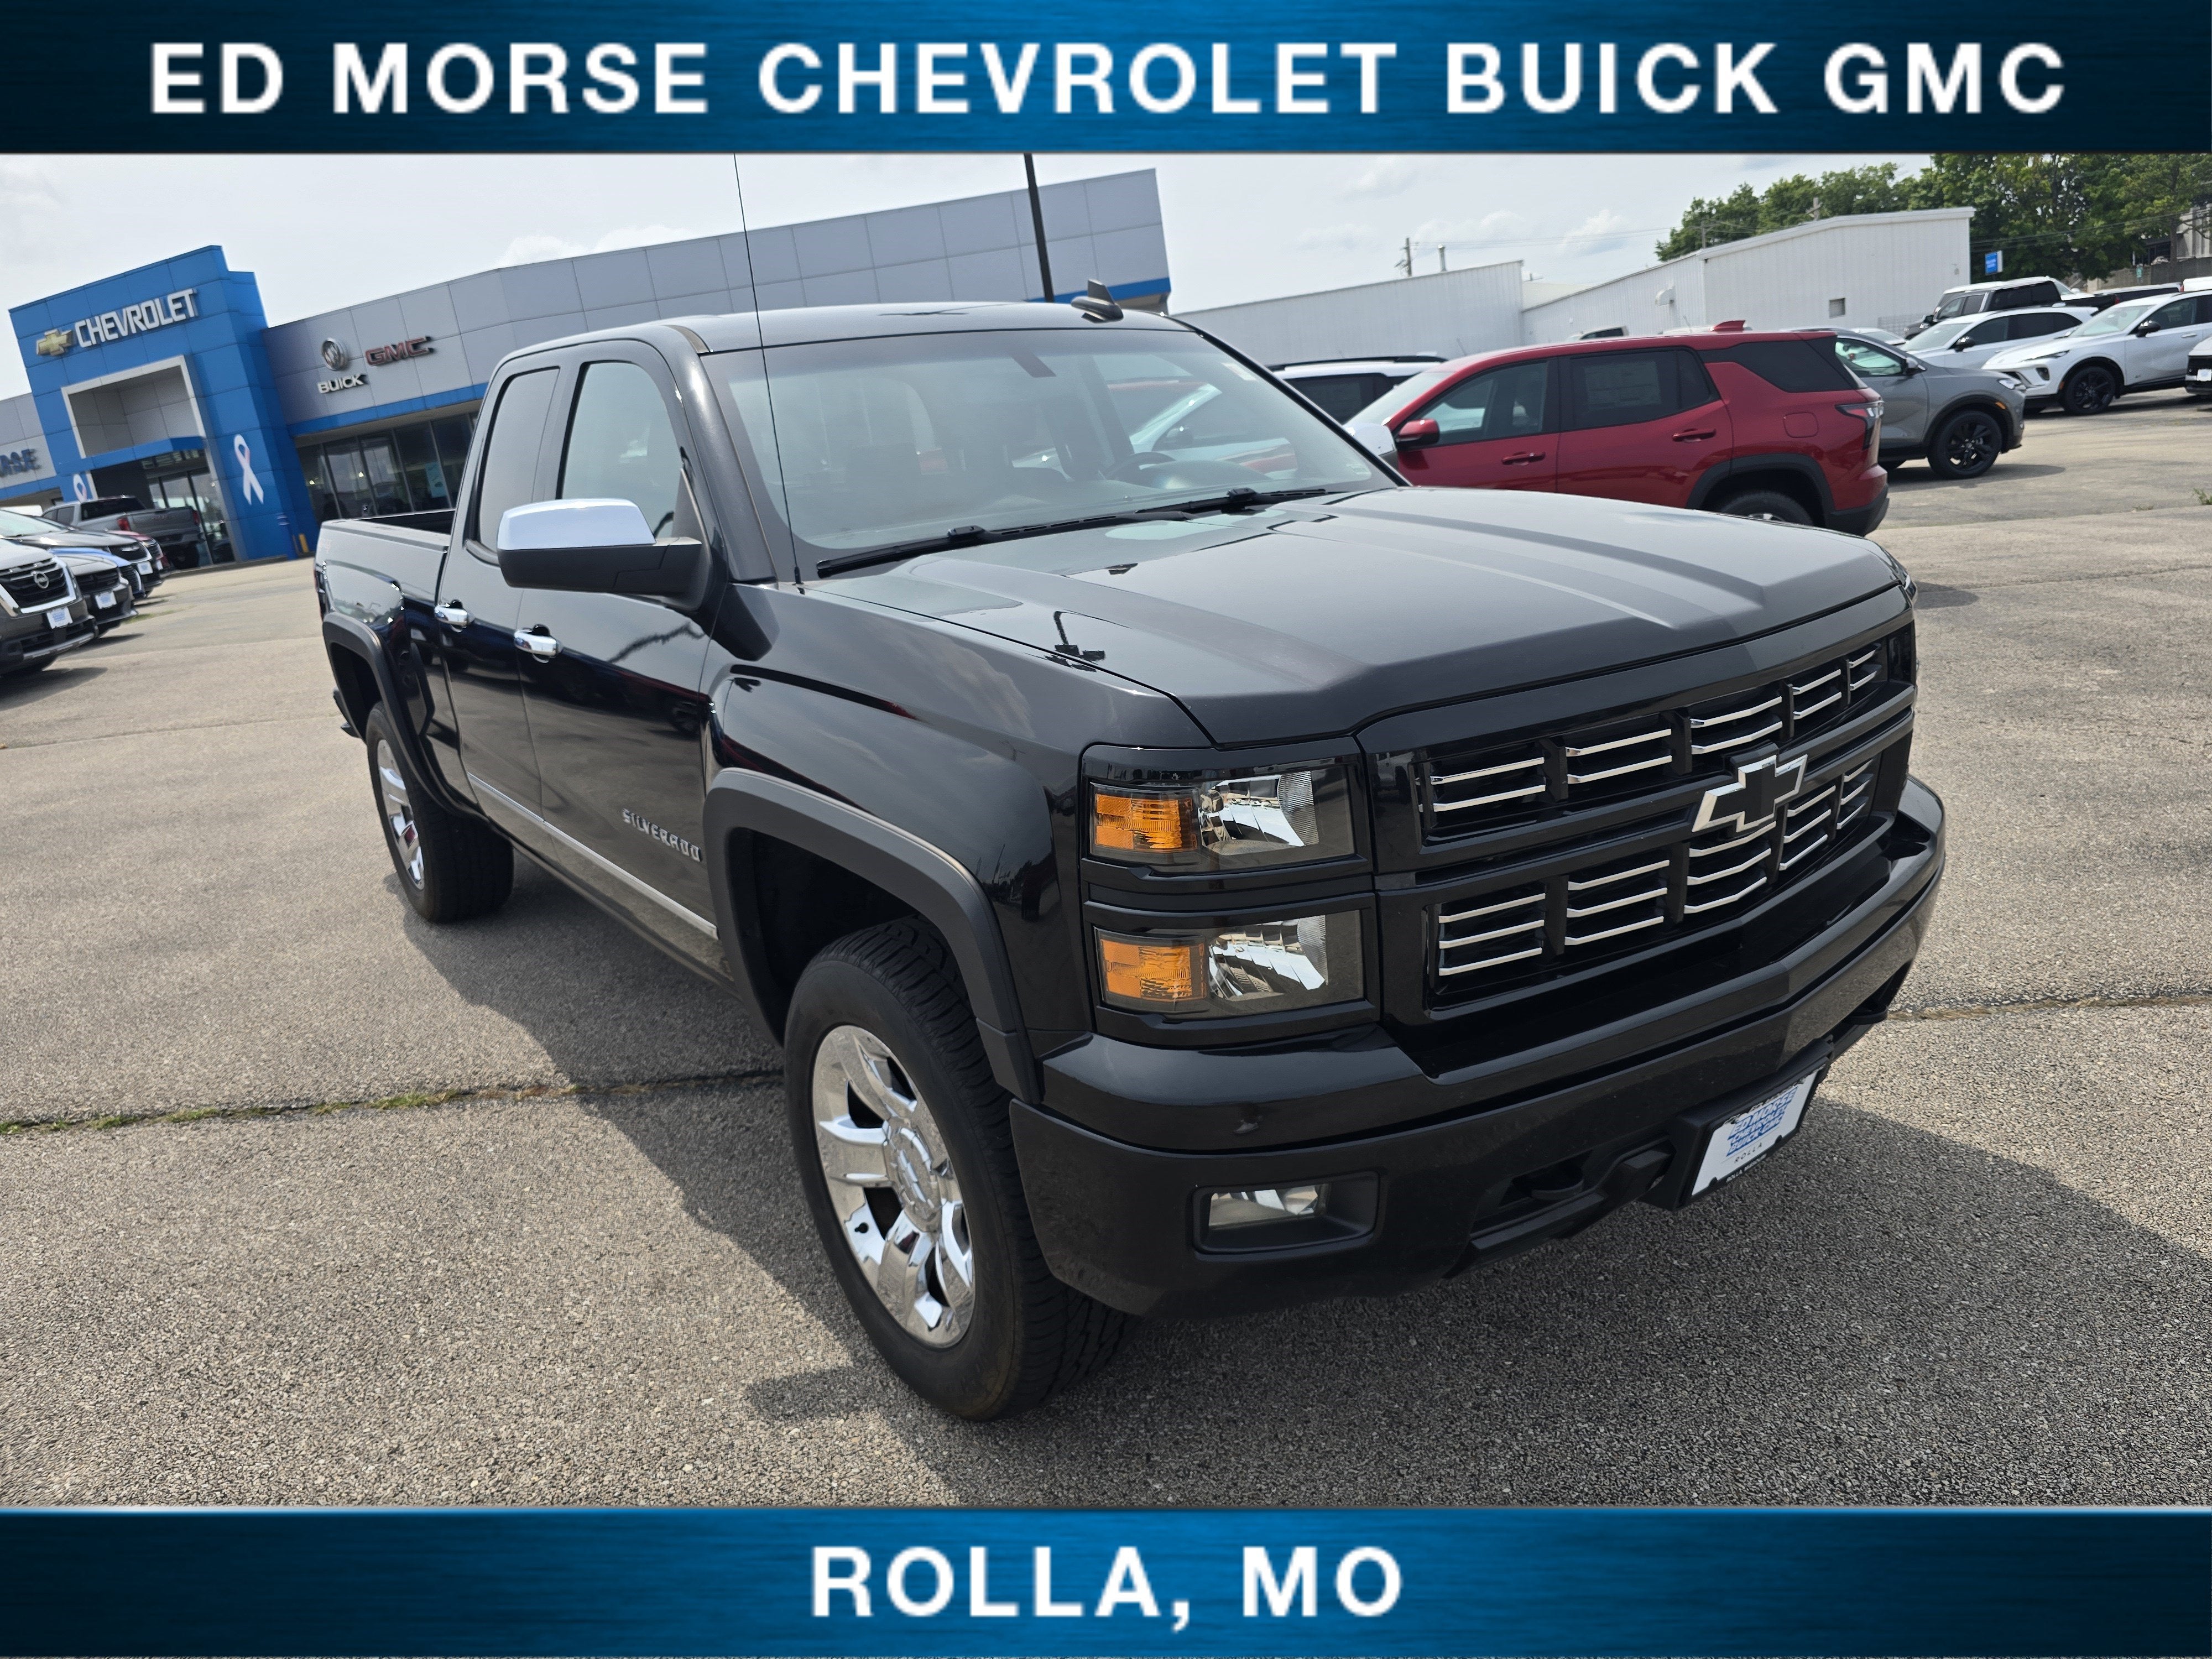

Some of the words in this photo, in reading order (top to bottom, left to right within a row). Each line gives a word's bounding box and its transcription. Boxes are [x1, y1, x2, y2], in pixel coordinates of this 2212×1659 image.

[74, 288, 197, 348] CHEVROLET
[365, 336, 430, 367] GMC
[317, 373, 364, 394] BUICK
[622, 807, 702, 862] SILVERADO
[1748, 1087, 1797, 1127] MORSE
